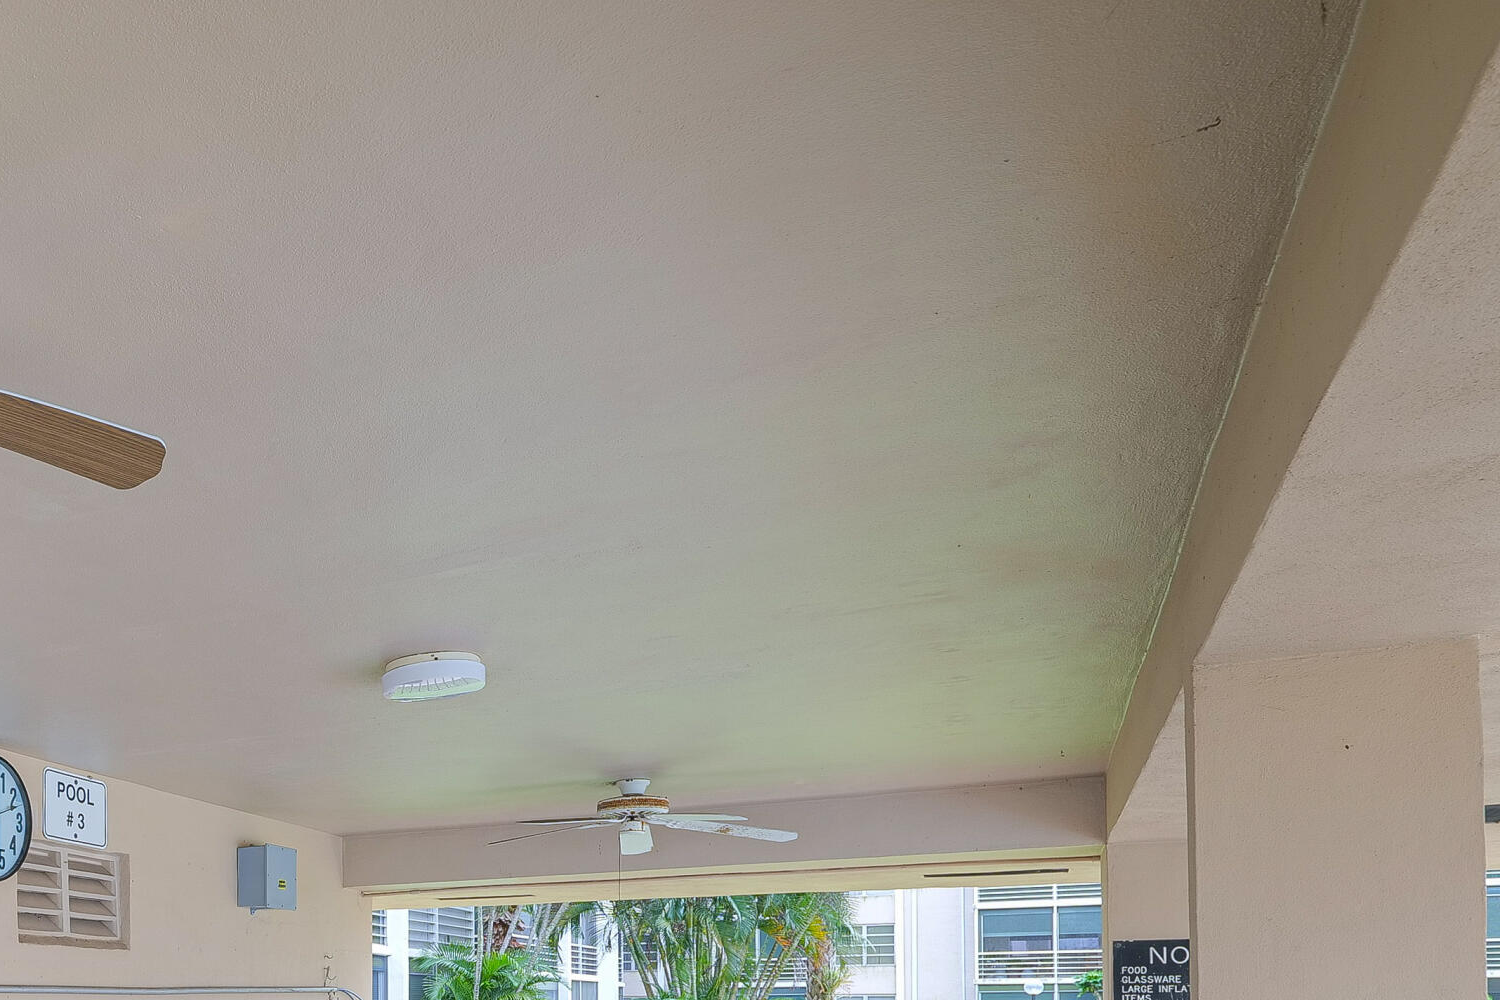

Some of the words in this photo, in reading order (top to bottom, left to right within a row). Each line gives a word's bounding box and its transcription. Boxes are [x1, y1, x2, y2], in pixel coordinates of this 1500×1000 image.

[0, 772, 5, 793] 1
[10, 788, 17, 810] 2
[57, 781, 94, 806] POOL
[16, 813, 23, 832] 3
[10, 835, 16, 855] 4
[0, 849, 5, 869] 5
[1150, 946, 1189, 964] NO
[1121, 975, 1181, 984] GLASSWARE
[1122, 966, 1147, 974] FOOD
[1122, 985, 1153, 993] LARGE
